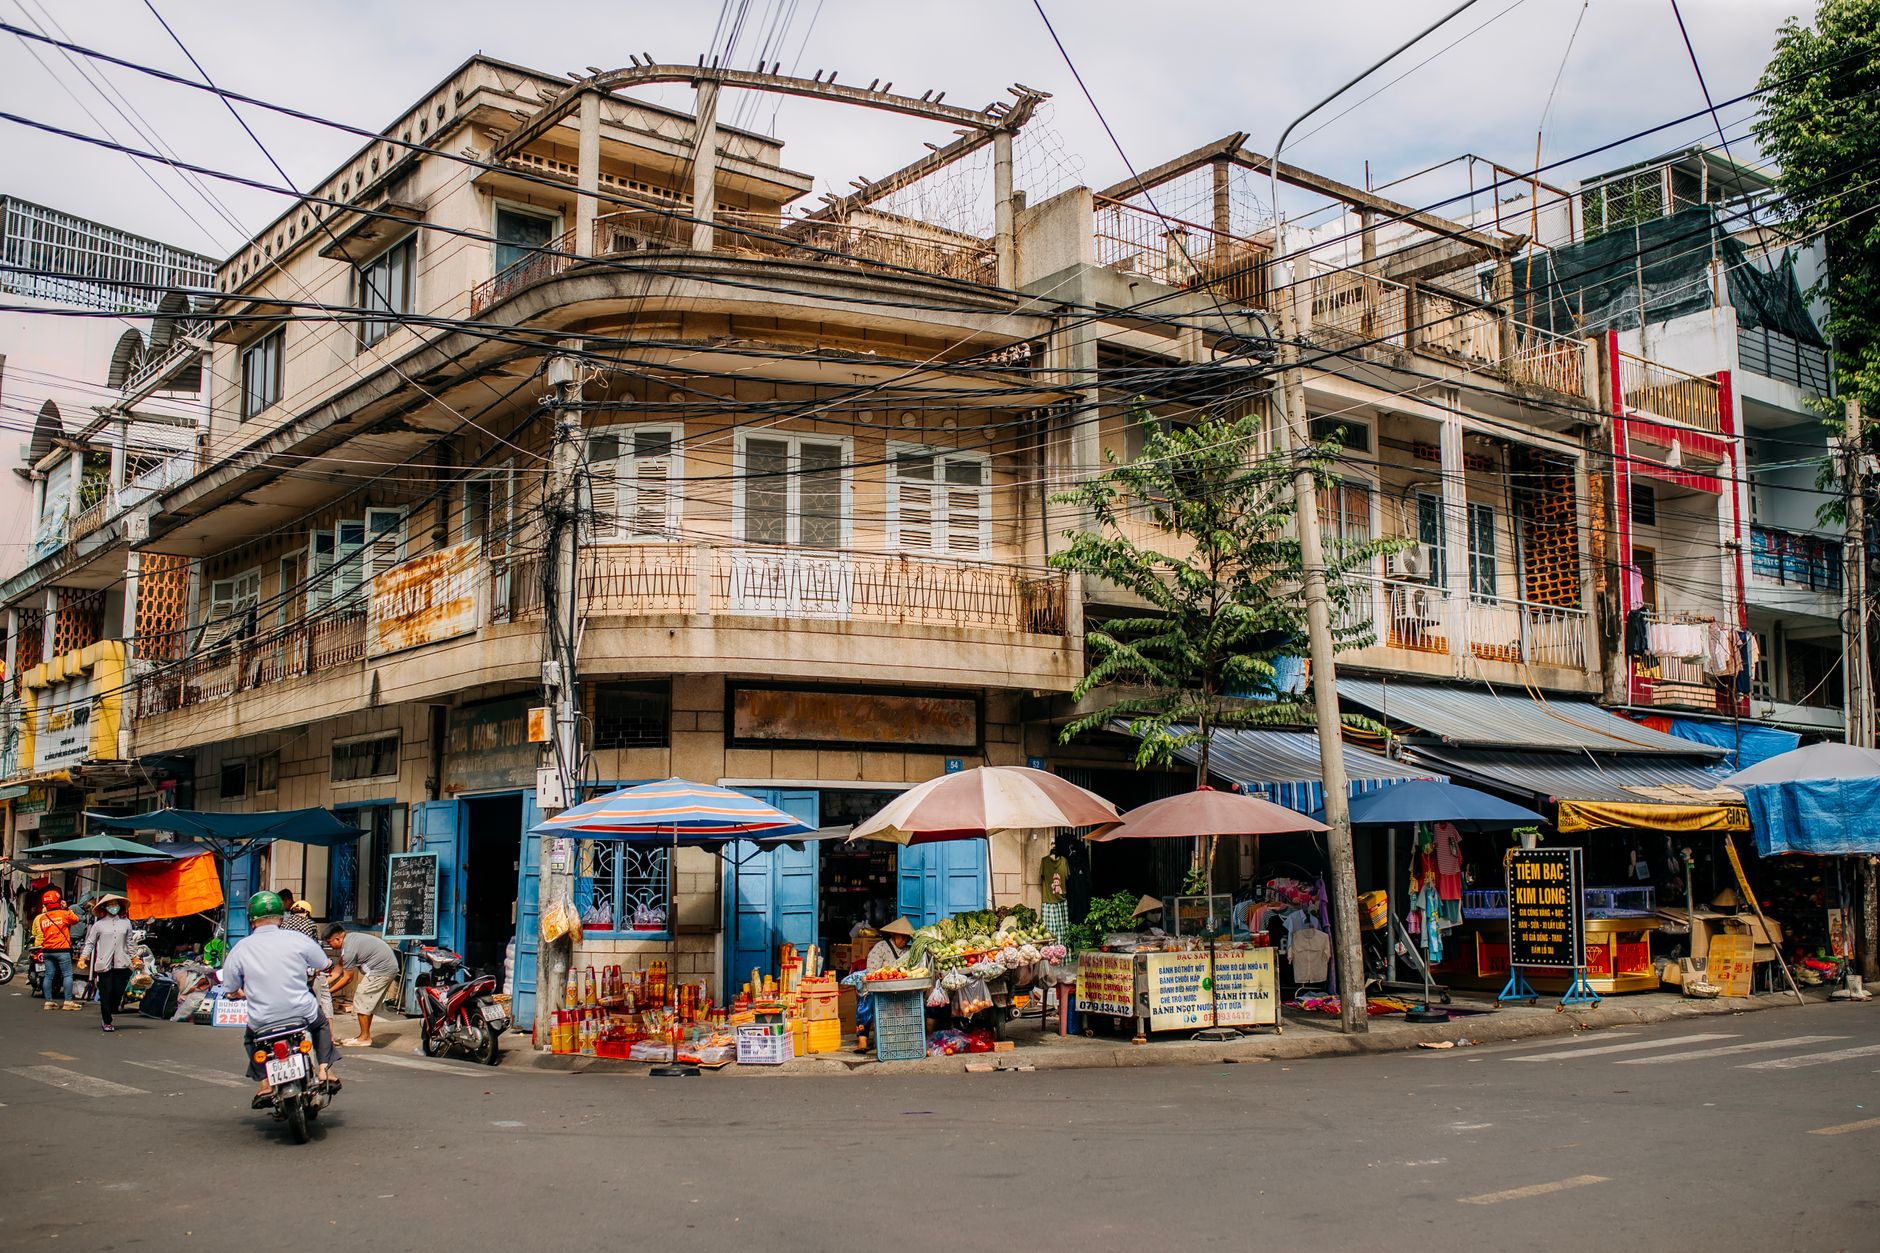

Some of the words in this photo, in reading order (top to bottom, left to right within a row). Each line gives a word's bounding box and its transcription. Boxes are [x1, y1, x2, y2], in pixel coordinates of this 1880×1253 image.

[950, 760, 958, 769] 54
[1032, 760, 1040, 769] 52
[1515, 860, 1540, 884] TIỆM
[1543, 863, 1564, 884] BẠC
[1516, 887, 1536, 905] KIM
[1538, 887, 1566, 905] LONG
[219, 1014, 248, 1025] 25K
[272, 1057, 297, 1073] 60-AA
[271, 1067, 302, 1085] 144.81
